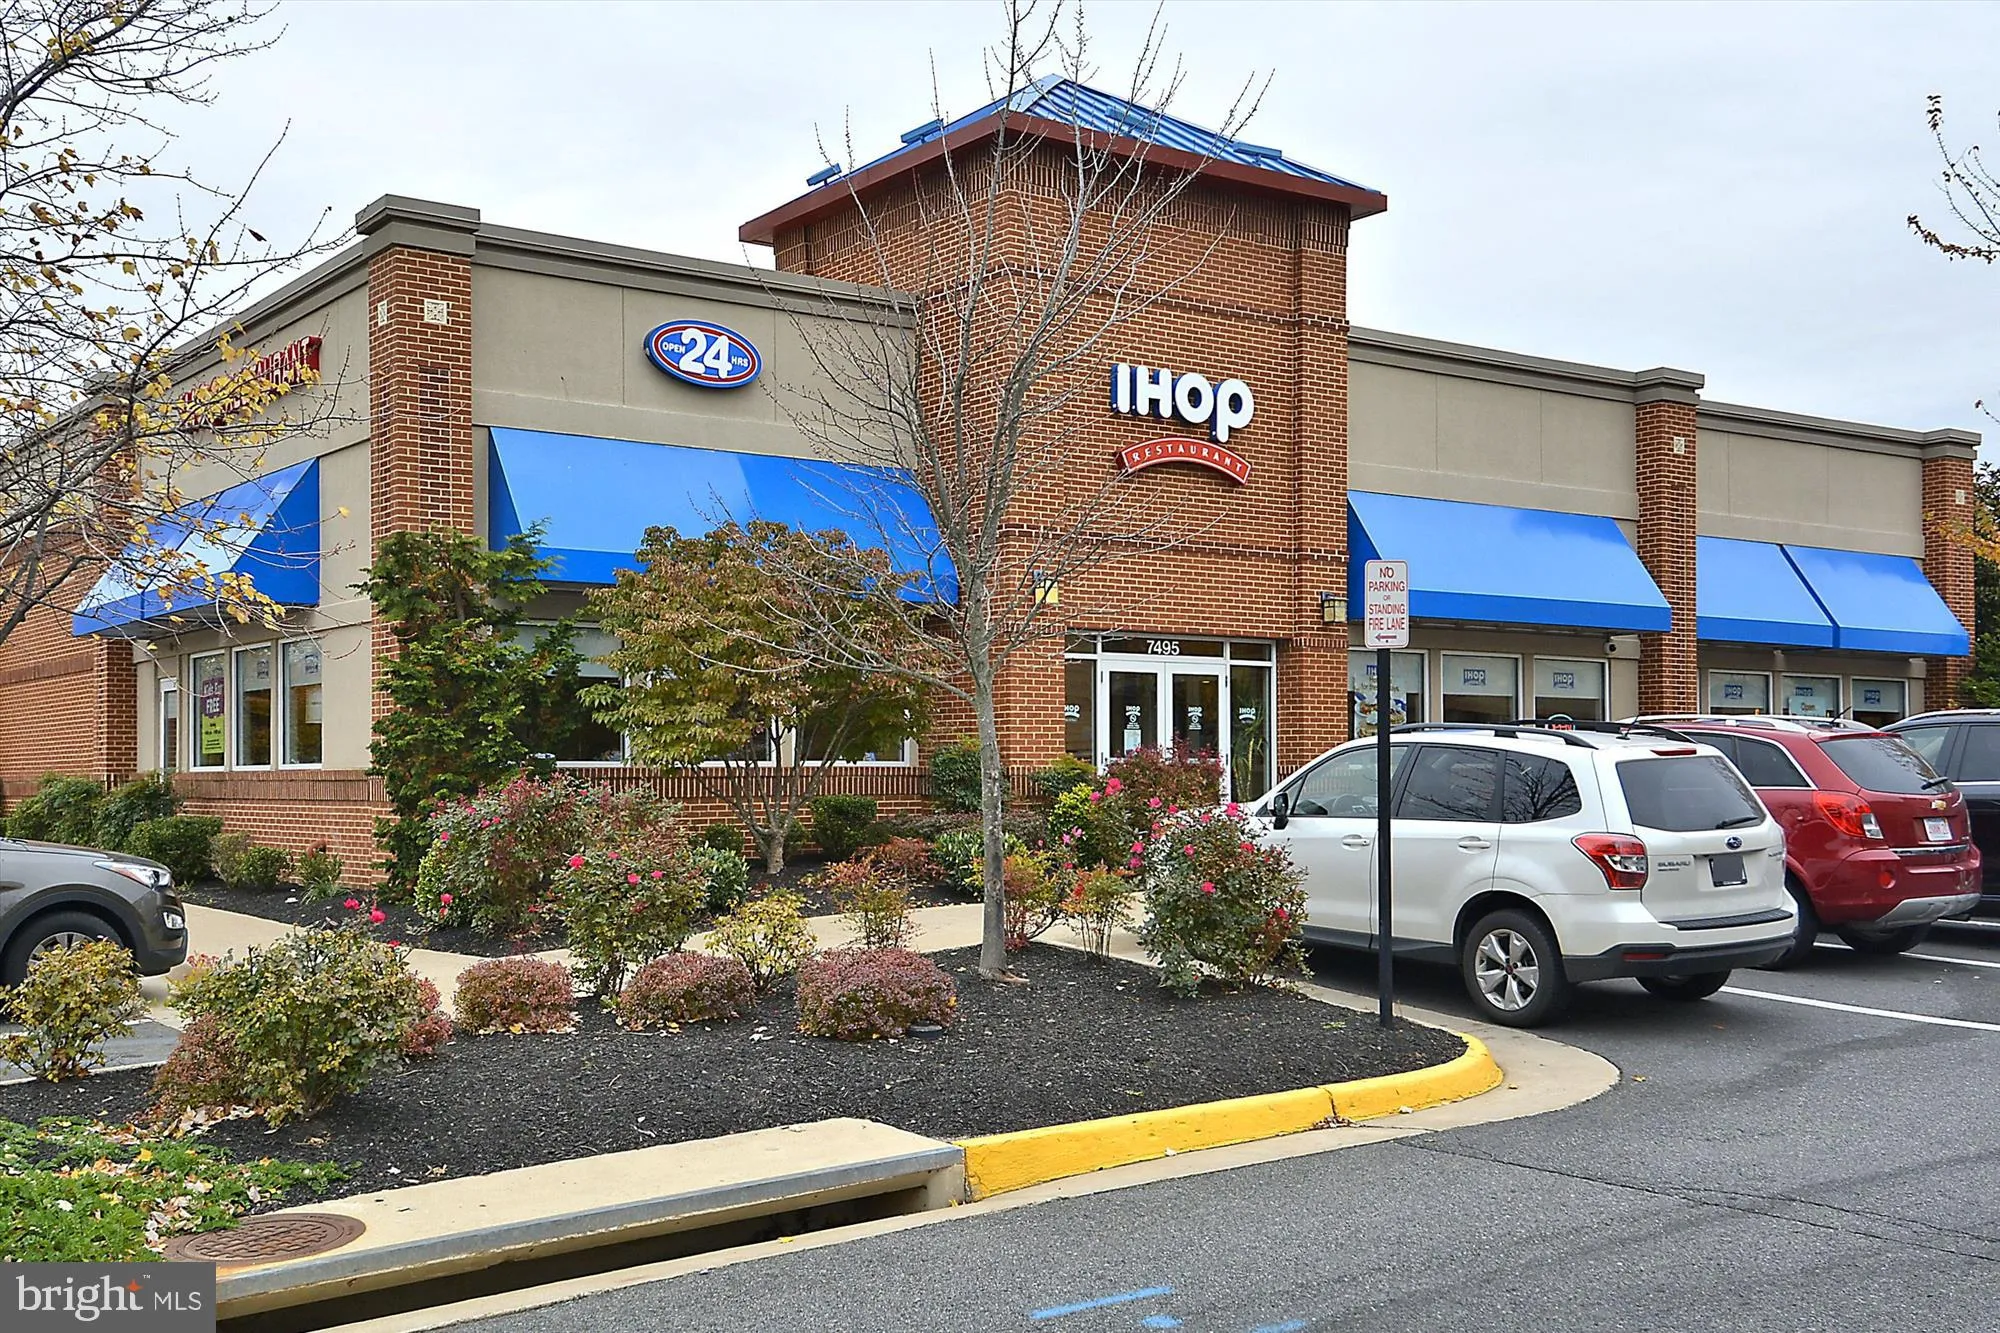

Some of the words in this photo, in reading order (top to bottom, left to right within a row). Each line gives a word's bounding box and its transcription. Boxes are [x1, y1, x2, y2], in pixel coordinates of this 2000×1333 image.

[662, 341, 686, 354] OPEN
[679, 327, 733, 379] 24
[731, 355, 749, 367] HRS
[1113, 363, 1255, 443] IHOP
[1131, 443, 1243, 473] RESTAURANT
[1379, 566, 1395, 578] NO
[1368, 581, 1406, 592] PARKING
[1368, 603, 1406, 615] STANDING
[1368, 617, 1385, 631] FIRE
[1386, 617, 1406, 631] LANE
[1146, 640, 1180, 656] 7495
[1464, 670, 1485, 682] IHOP
[1553, 674, 1573, 685] IHOP
[206, 697, 220, 714] FREE
[1064, 704, 1080, 713] HOP
[1239, 707, 1256, 715] IHOP
